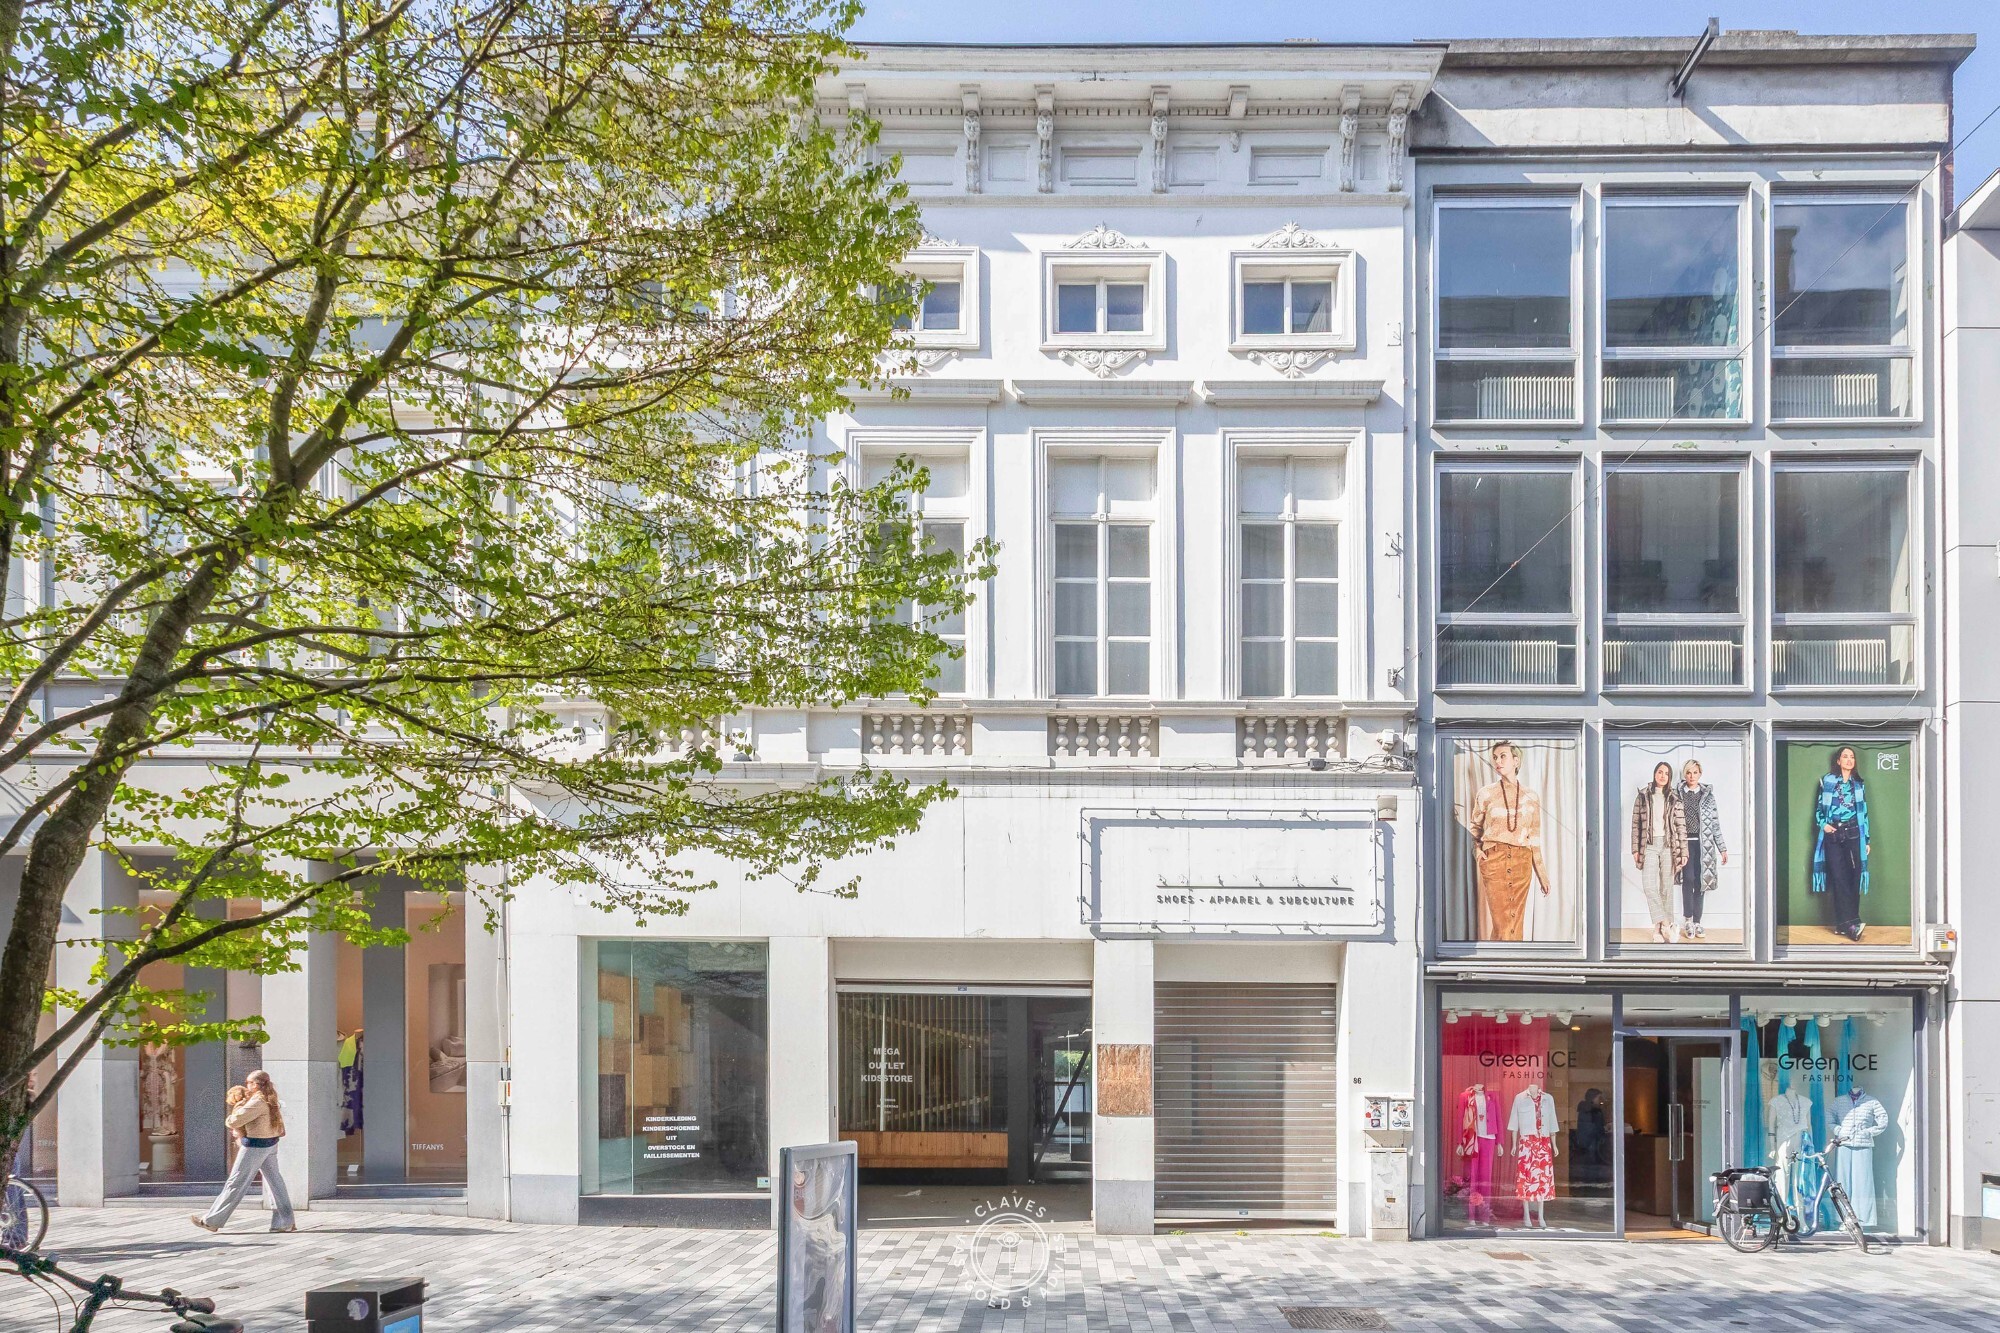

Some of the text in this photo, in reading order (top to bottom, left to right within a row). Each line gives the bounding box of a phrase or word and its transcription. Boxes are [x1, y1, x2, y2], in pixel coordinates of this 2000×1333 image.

[1877, 759, 1899, 770] ICE
[1156, 895, 1195, 904] SHOES
[1209, 895, 1262, 905] APPAREL
[1278, 896, 1355, 906] SUBCULTURE
[873, 1047, 900, 1055] MEGA
[1479, 1050, 1577, 1068] Green ICE
[1778, 1053, 1878, 1071] Green ICE
[868, 1062, 905, 1070] OUTLET
[860, 1074, 913, 1083] KIDSSTORE
[1503, 1071, 1553, 1079] FASHION
[1802, 1074, 1854, 1082] FASHION
[645, 1115, 697, 1123] KINDERKLEDING
